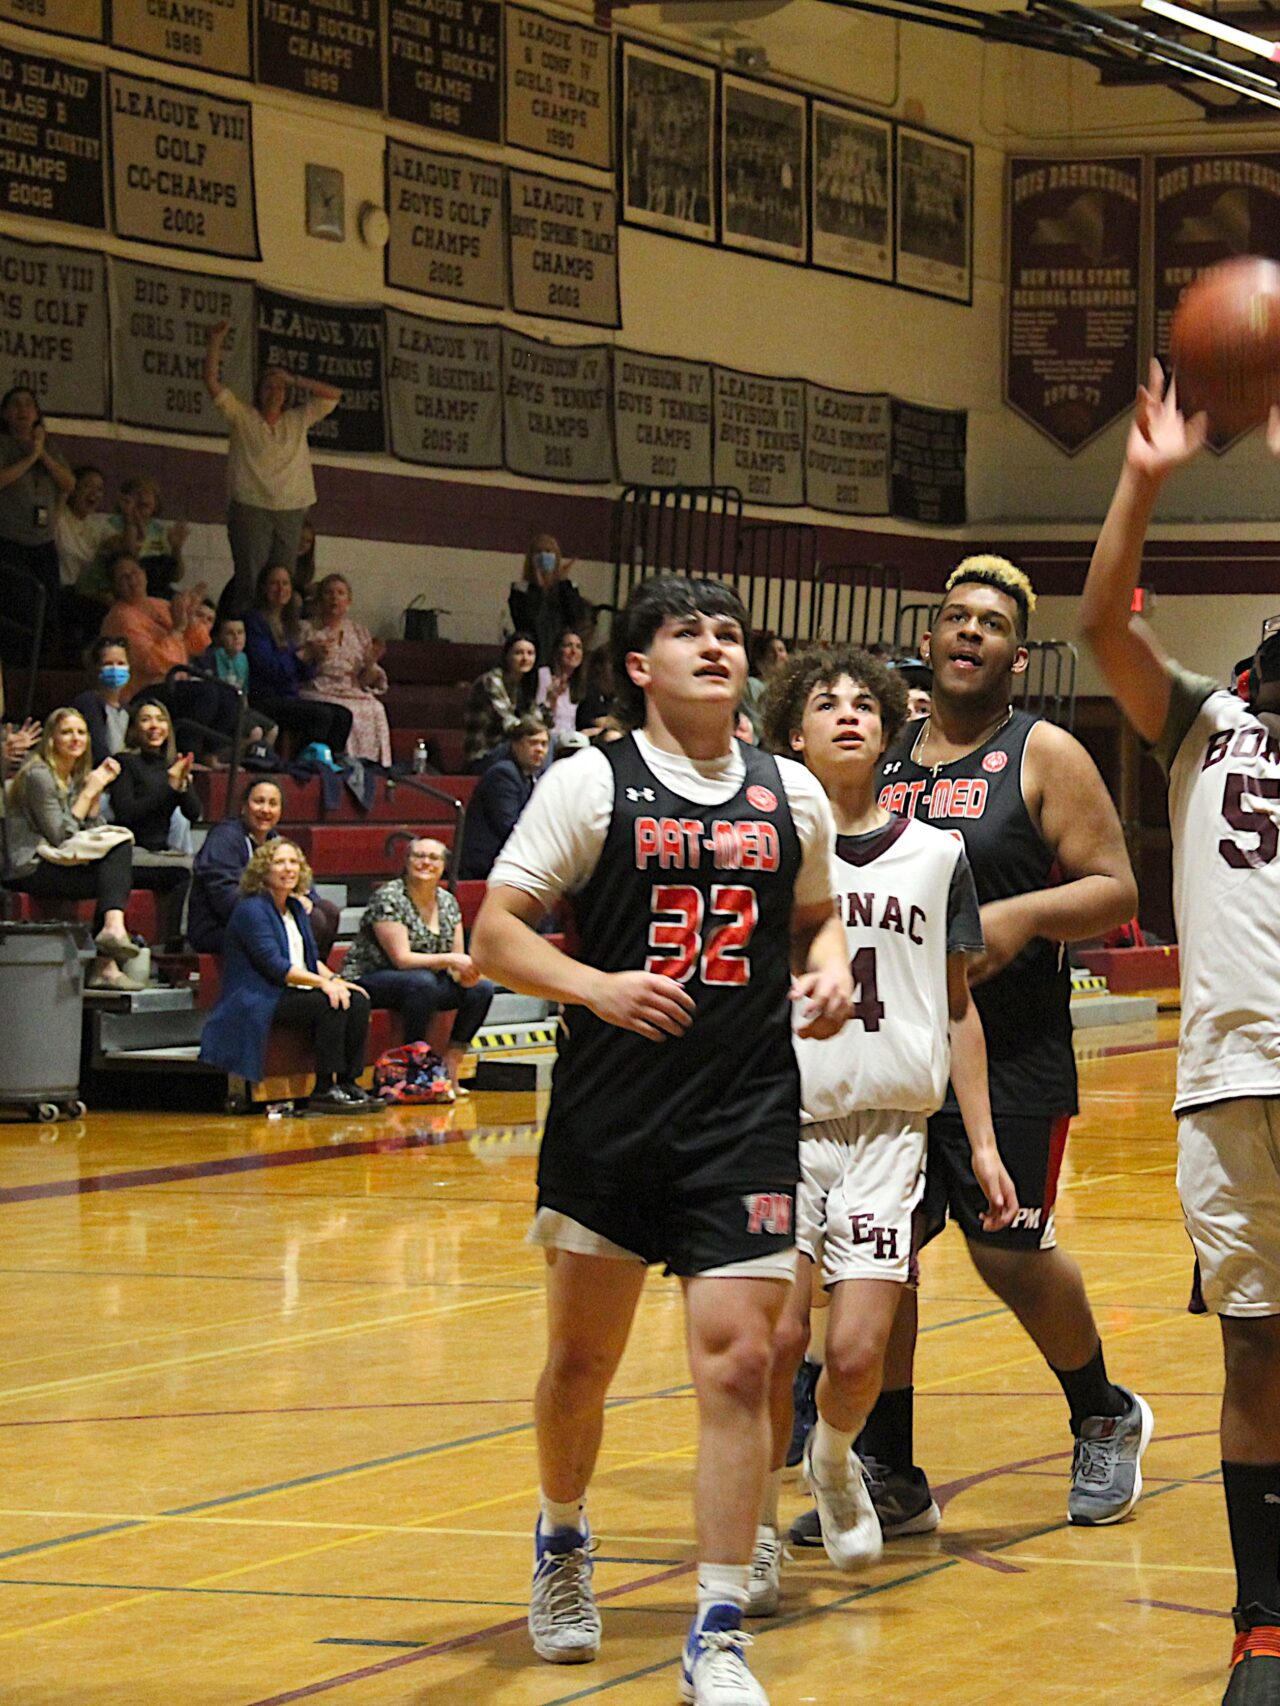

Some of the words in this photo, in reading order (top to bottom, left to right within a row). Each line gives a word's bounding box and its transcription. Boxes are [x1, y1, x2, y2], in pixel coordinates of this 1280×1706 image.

[518, 20, 572, 51] LEAGUE
[288, 36, 353, 70] CHAMPS
[22, 64, 88, 99] ISLAND
[115, 87, 200, 132] LEAGUE
[208, 111, 245, 142] VIII
[531, 98, 588, 129] CHAMPS
[155, 134, 207, 168] GOLF
[127, 163, 238, 208] CO-CHAMPS
[393, 158, 463, 192] LEAGUE
[397, 188, 444, 219] BOYS
[448, 200, 492, 229] GOLF
[522, 186, 585, 218] LEAGUE
[591, 201, 604, 222] V
[162, 206, 206, 237] 2002
[411, 225, 481, 259] CHAMPS
[0, 256, 48, 287] GUE
[56, 265, 94, 293] VIII
[532, 250, 594, 282] CHAMPS
[34, 297, 89, 328] GOLF
[134, 278, 169, 307] BIG
[180, 287, 232, 316] FOUR
[130, 312, 175, 342] GIRLS
[259, 304, 345, 345] LEAGUE
[0, 329, 73, 362] HAMPS
[398, 328, 467, 360] LEAGUE
[267, 345, 309, 373] BOYS
[317, 354, 374, 378] TENNIS
[510, 346, 578, 380] DIVISION
[622, 362, 682, 392] DIVISION
[166, 388, 203, 415] 2015
[506, 374, 545, 405] BOYS
[718, 375, 775, 405] LEAGUE
[415, 394, 480, 423] CHAMPS
[617, 390, 653, 416] BOYS
[659, 397, 710, 425] TENNIS
[527, 410, 589, 440] CHAMPS
[636, 423, 692, 450] CHAMPS
[734, 448, 786, 475] CHAMPS
[877, 778, 989, 819] PAT-MED
[635, 816, 781, 873] PAT-MED
[644, 884, 759, 987] 32
[837, 892, 927, 946] NAC
[848, 1212, 899, 1259] EH
[1010, 1207, 1042, 1230] PM
